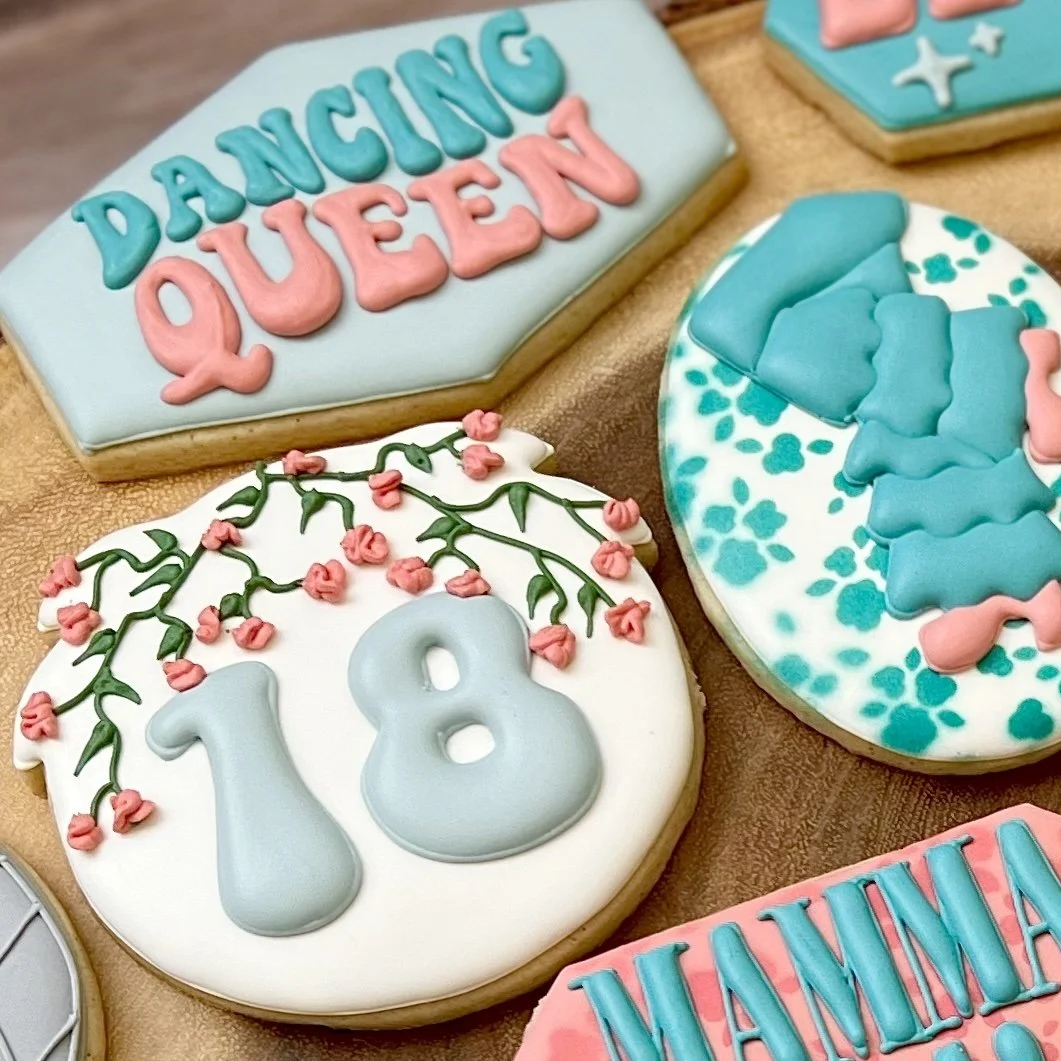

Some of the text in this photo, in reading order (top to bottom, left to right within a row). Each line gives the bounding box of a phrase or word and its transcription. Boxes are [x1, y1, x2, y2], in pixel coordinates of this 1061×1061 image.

[72, 7, 566, 290] DANCING
[134, 95, 641, 405] QUEEN
[145, 592, 602, 938] 18
